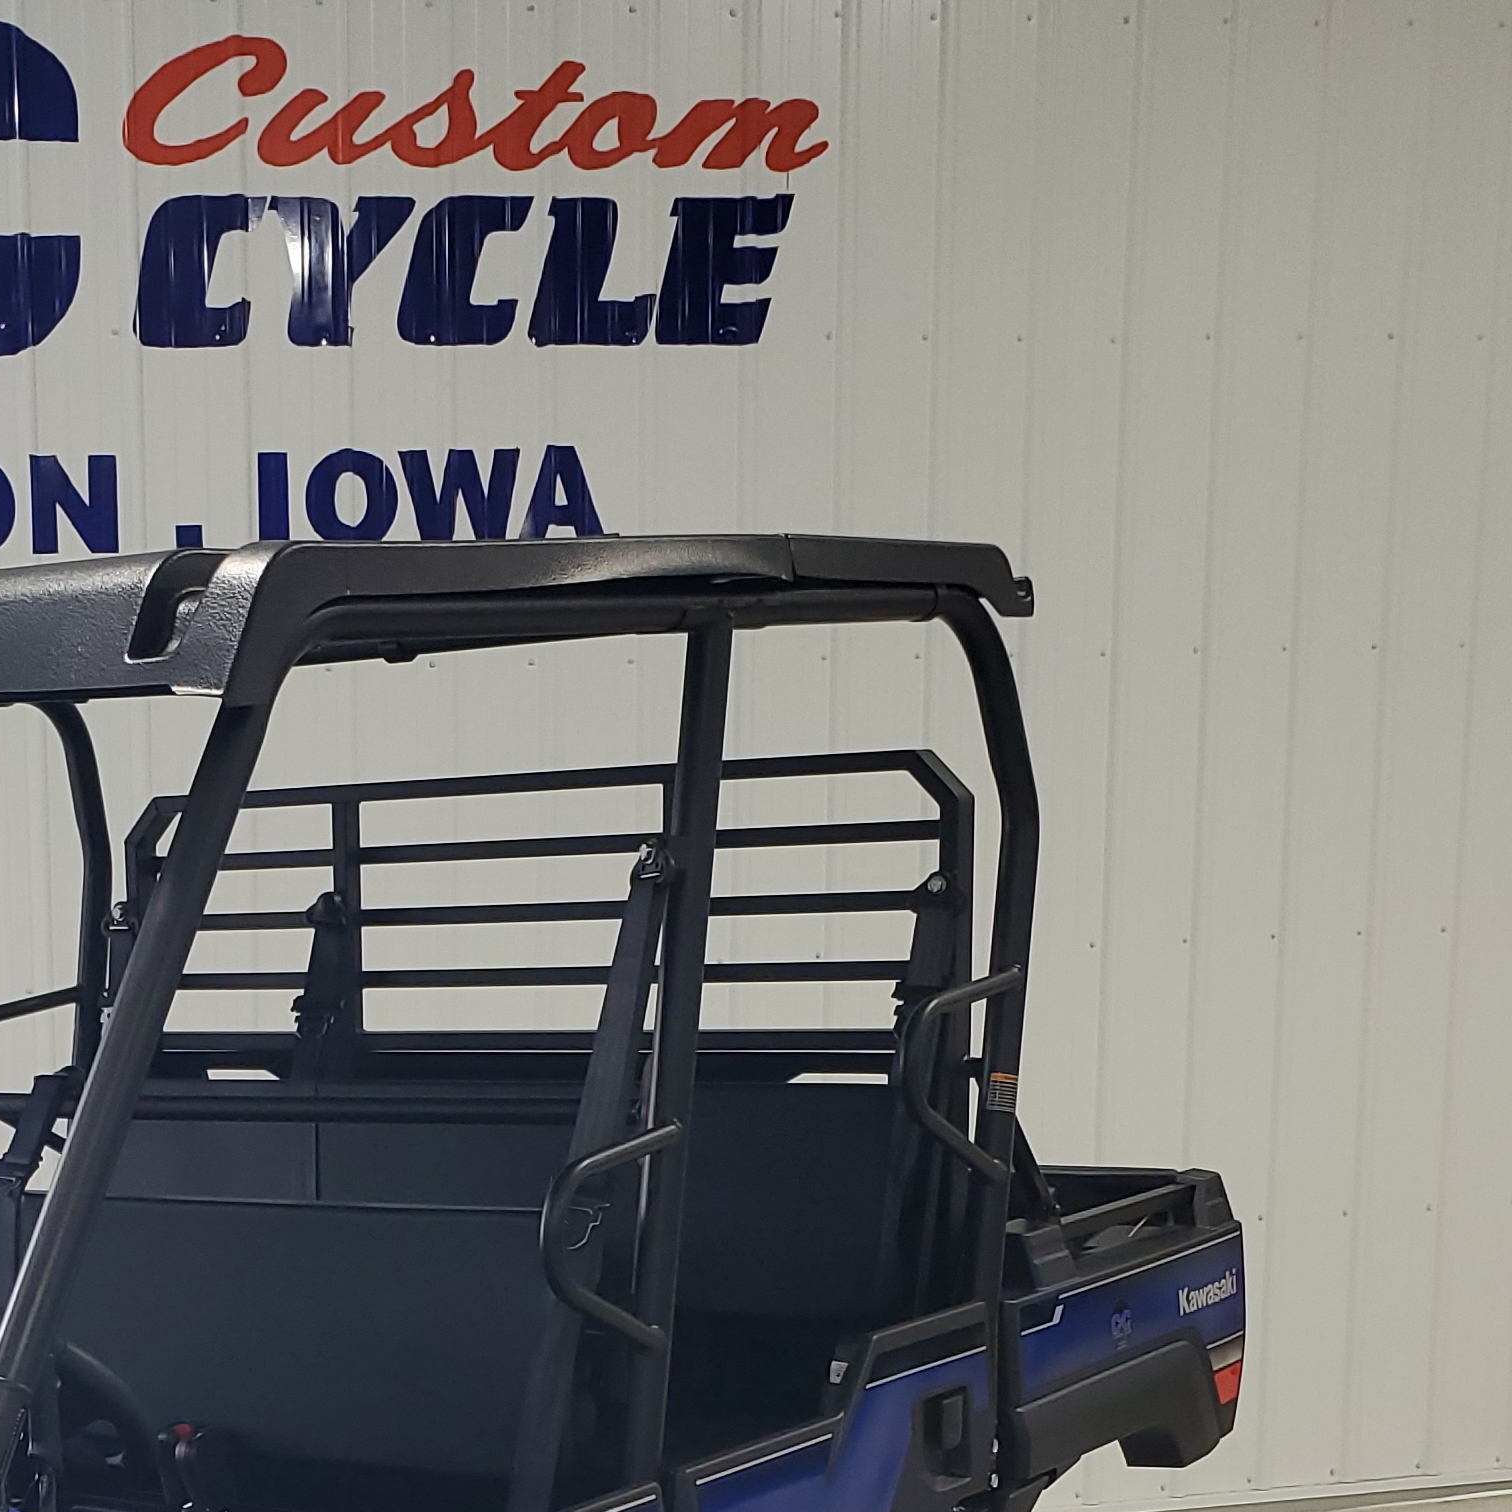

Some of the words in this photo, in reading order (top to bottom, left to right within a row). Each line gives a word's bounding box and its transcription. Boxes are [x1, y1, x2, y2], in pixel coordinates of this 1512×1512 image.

[122, 34, 829, 172] Custom
[133, 193, 795, 348] CYCLE
[256, 443, 606, 543] IOWA
[1178, 1268, 1237, 1316] Kawasaki
